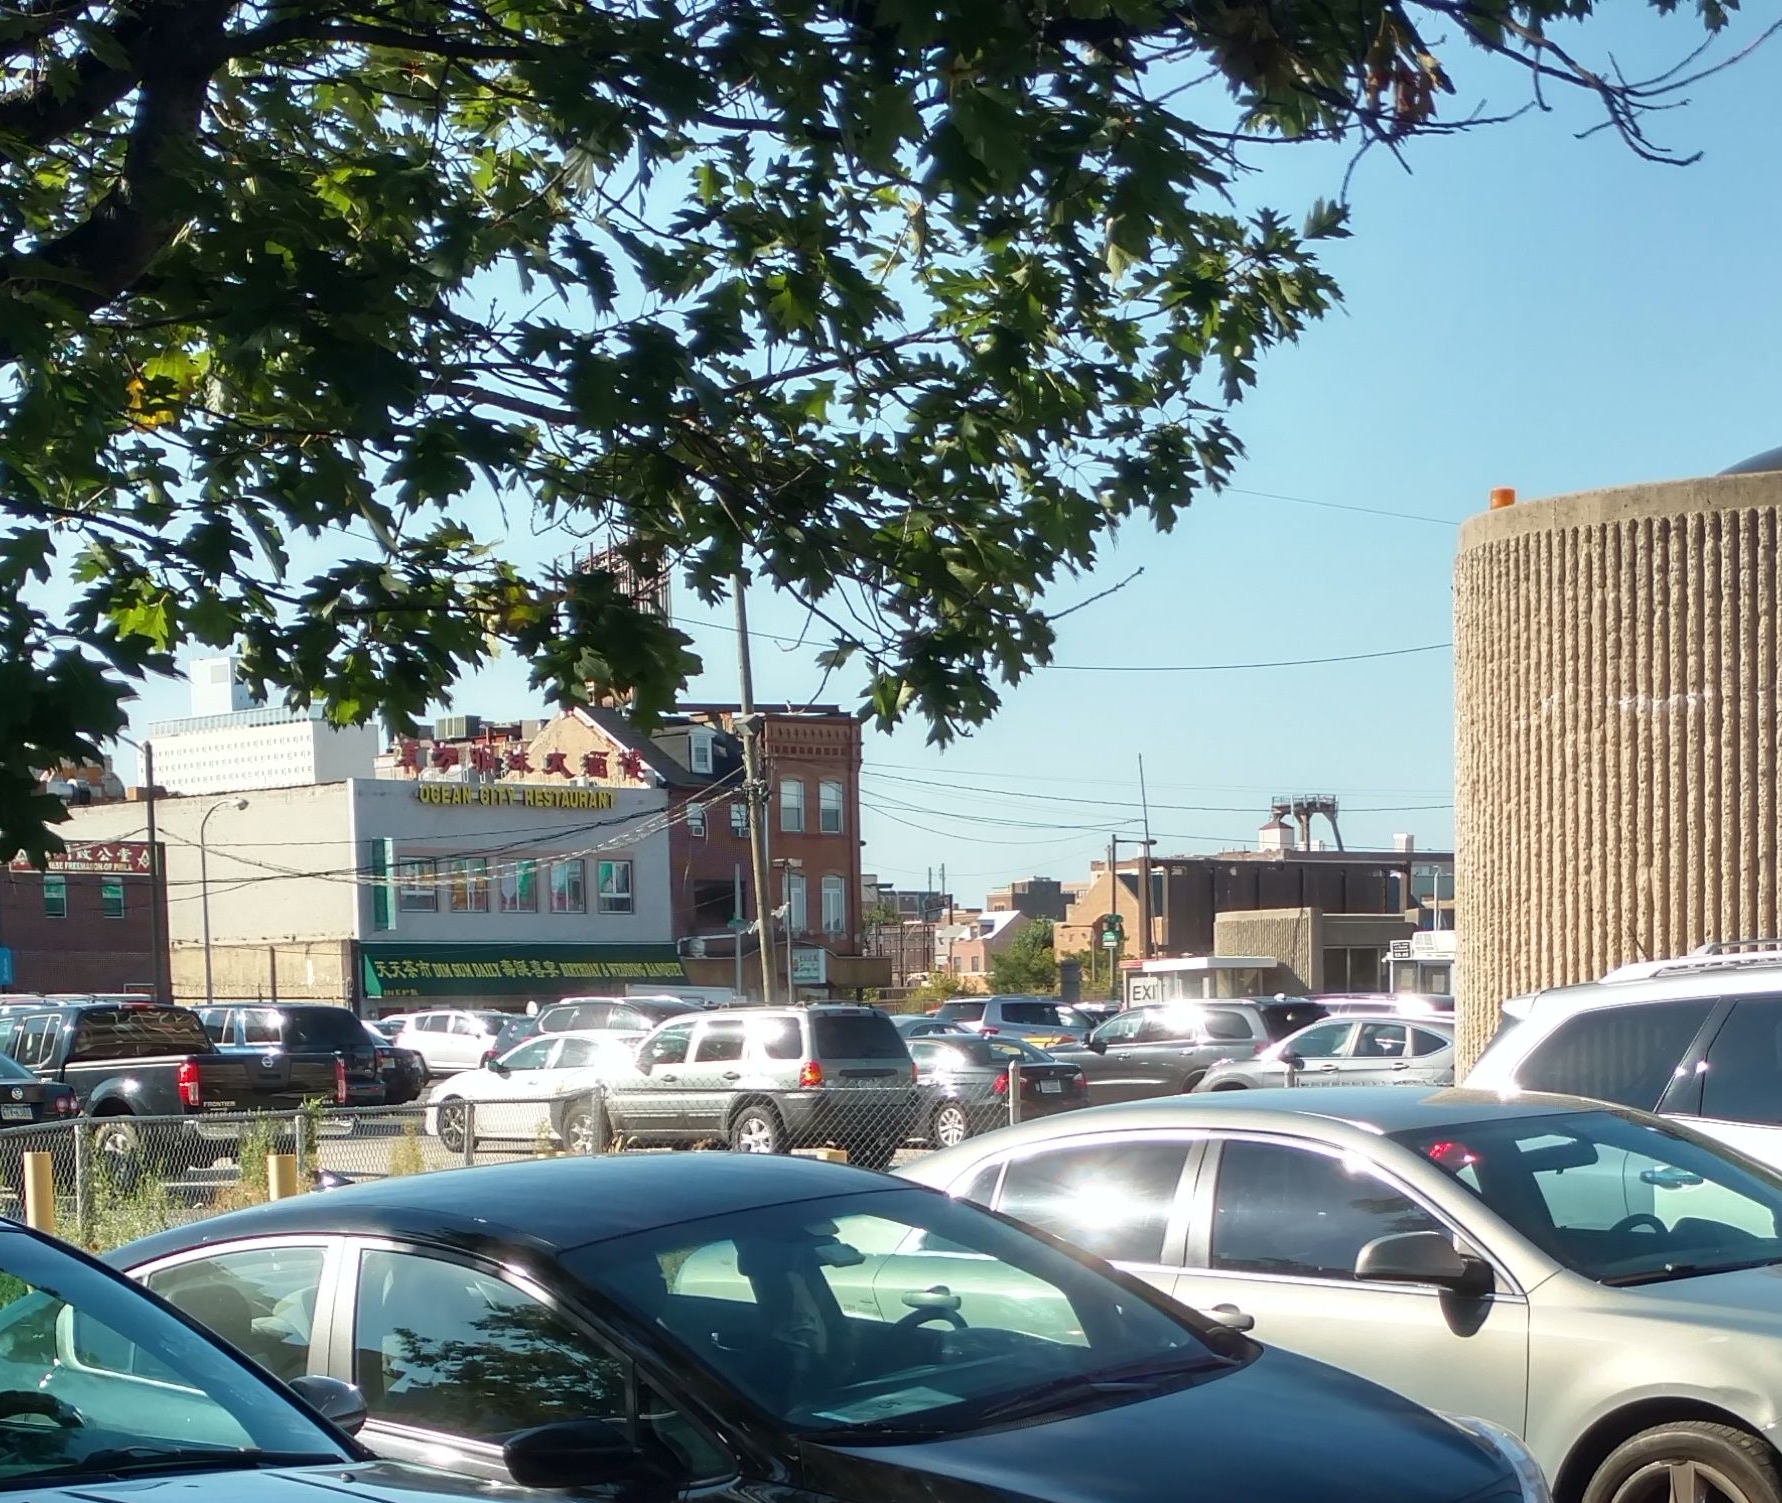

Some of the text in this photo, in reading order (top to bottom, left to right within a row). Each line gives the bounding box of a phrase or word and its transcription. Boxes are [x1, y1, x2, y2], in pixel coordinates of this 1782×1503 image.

[419, 784, 617, 810] OCEAN CITY RESTAURANT
[431, 963, 453, 978] DIM
[451, 963, 474, 978] SUM
[472, 963, 502, 978] DAILY
